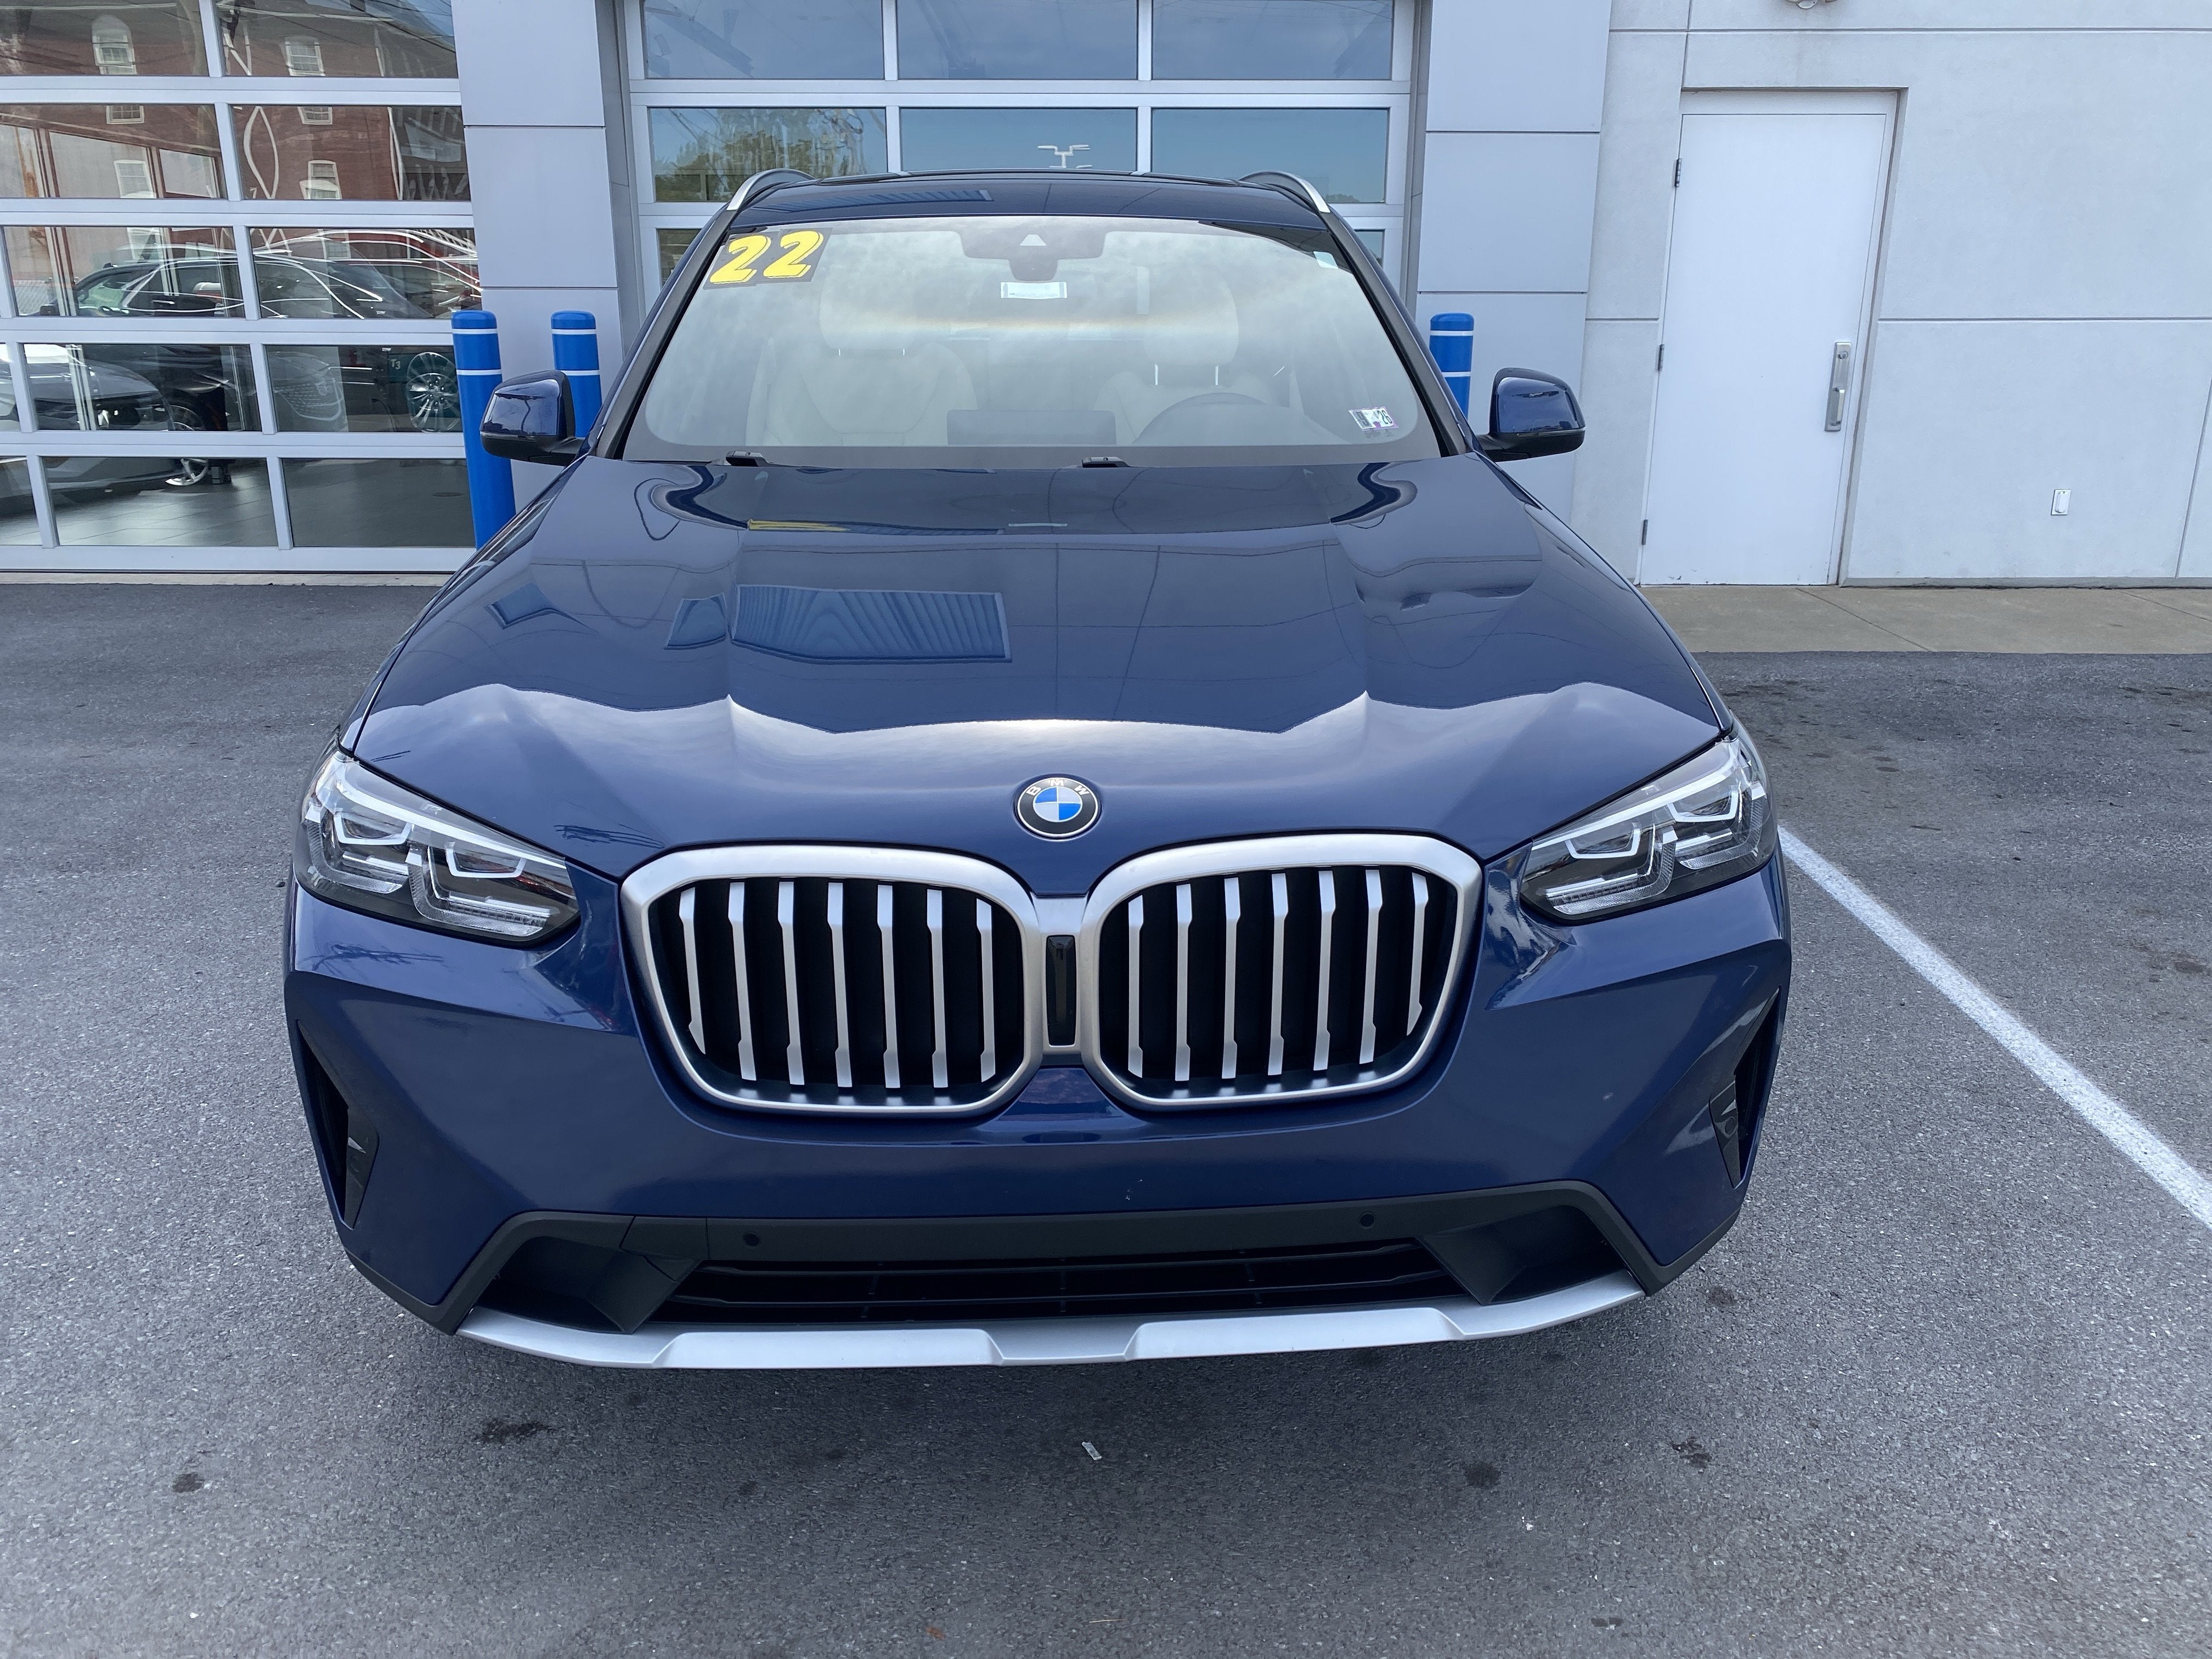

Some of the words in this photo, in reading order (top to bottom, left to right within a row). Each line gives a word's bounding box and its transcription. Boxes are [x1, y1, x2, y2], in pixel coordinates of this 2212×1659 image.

[710, 230, 823, 284] 22
[1377, 410, 1393, 424] 26
[1026, 779, 1090, 795] BMW
